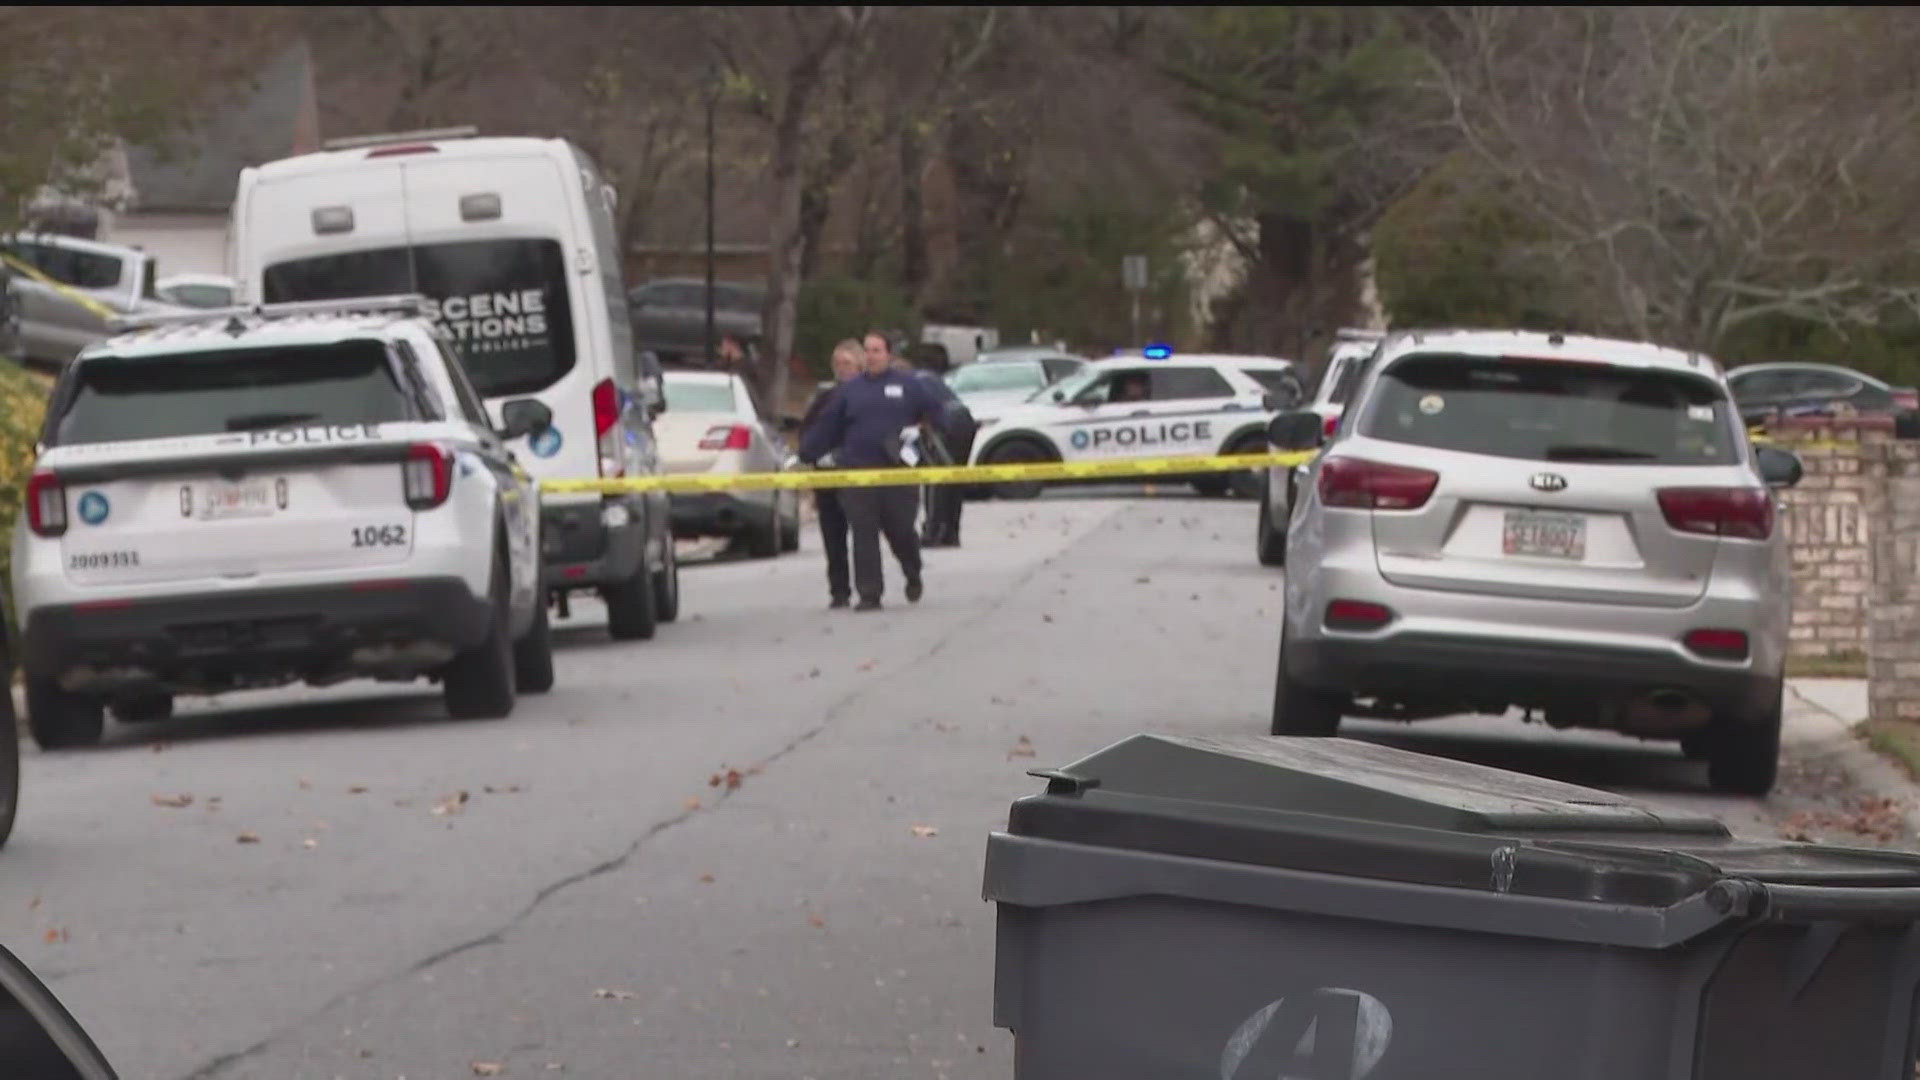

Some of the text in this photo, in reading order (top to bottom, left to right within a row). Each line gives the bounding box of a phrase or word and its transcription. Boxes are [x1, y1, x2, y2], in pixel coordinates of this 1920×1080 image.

[418, 289, 546, 323] SCENE
[437, 313, 548, 341] ATIONS
[250, 423, 382, 446] POLICE
[1093, 421, 1213, 447] POLICE
[1532, 474, 1563, 489] KIA
[351, 525, 406, 548] 1062
